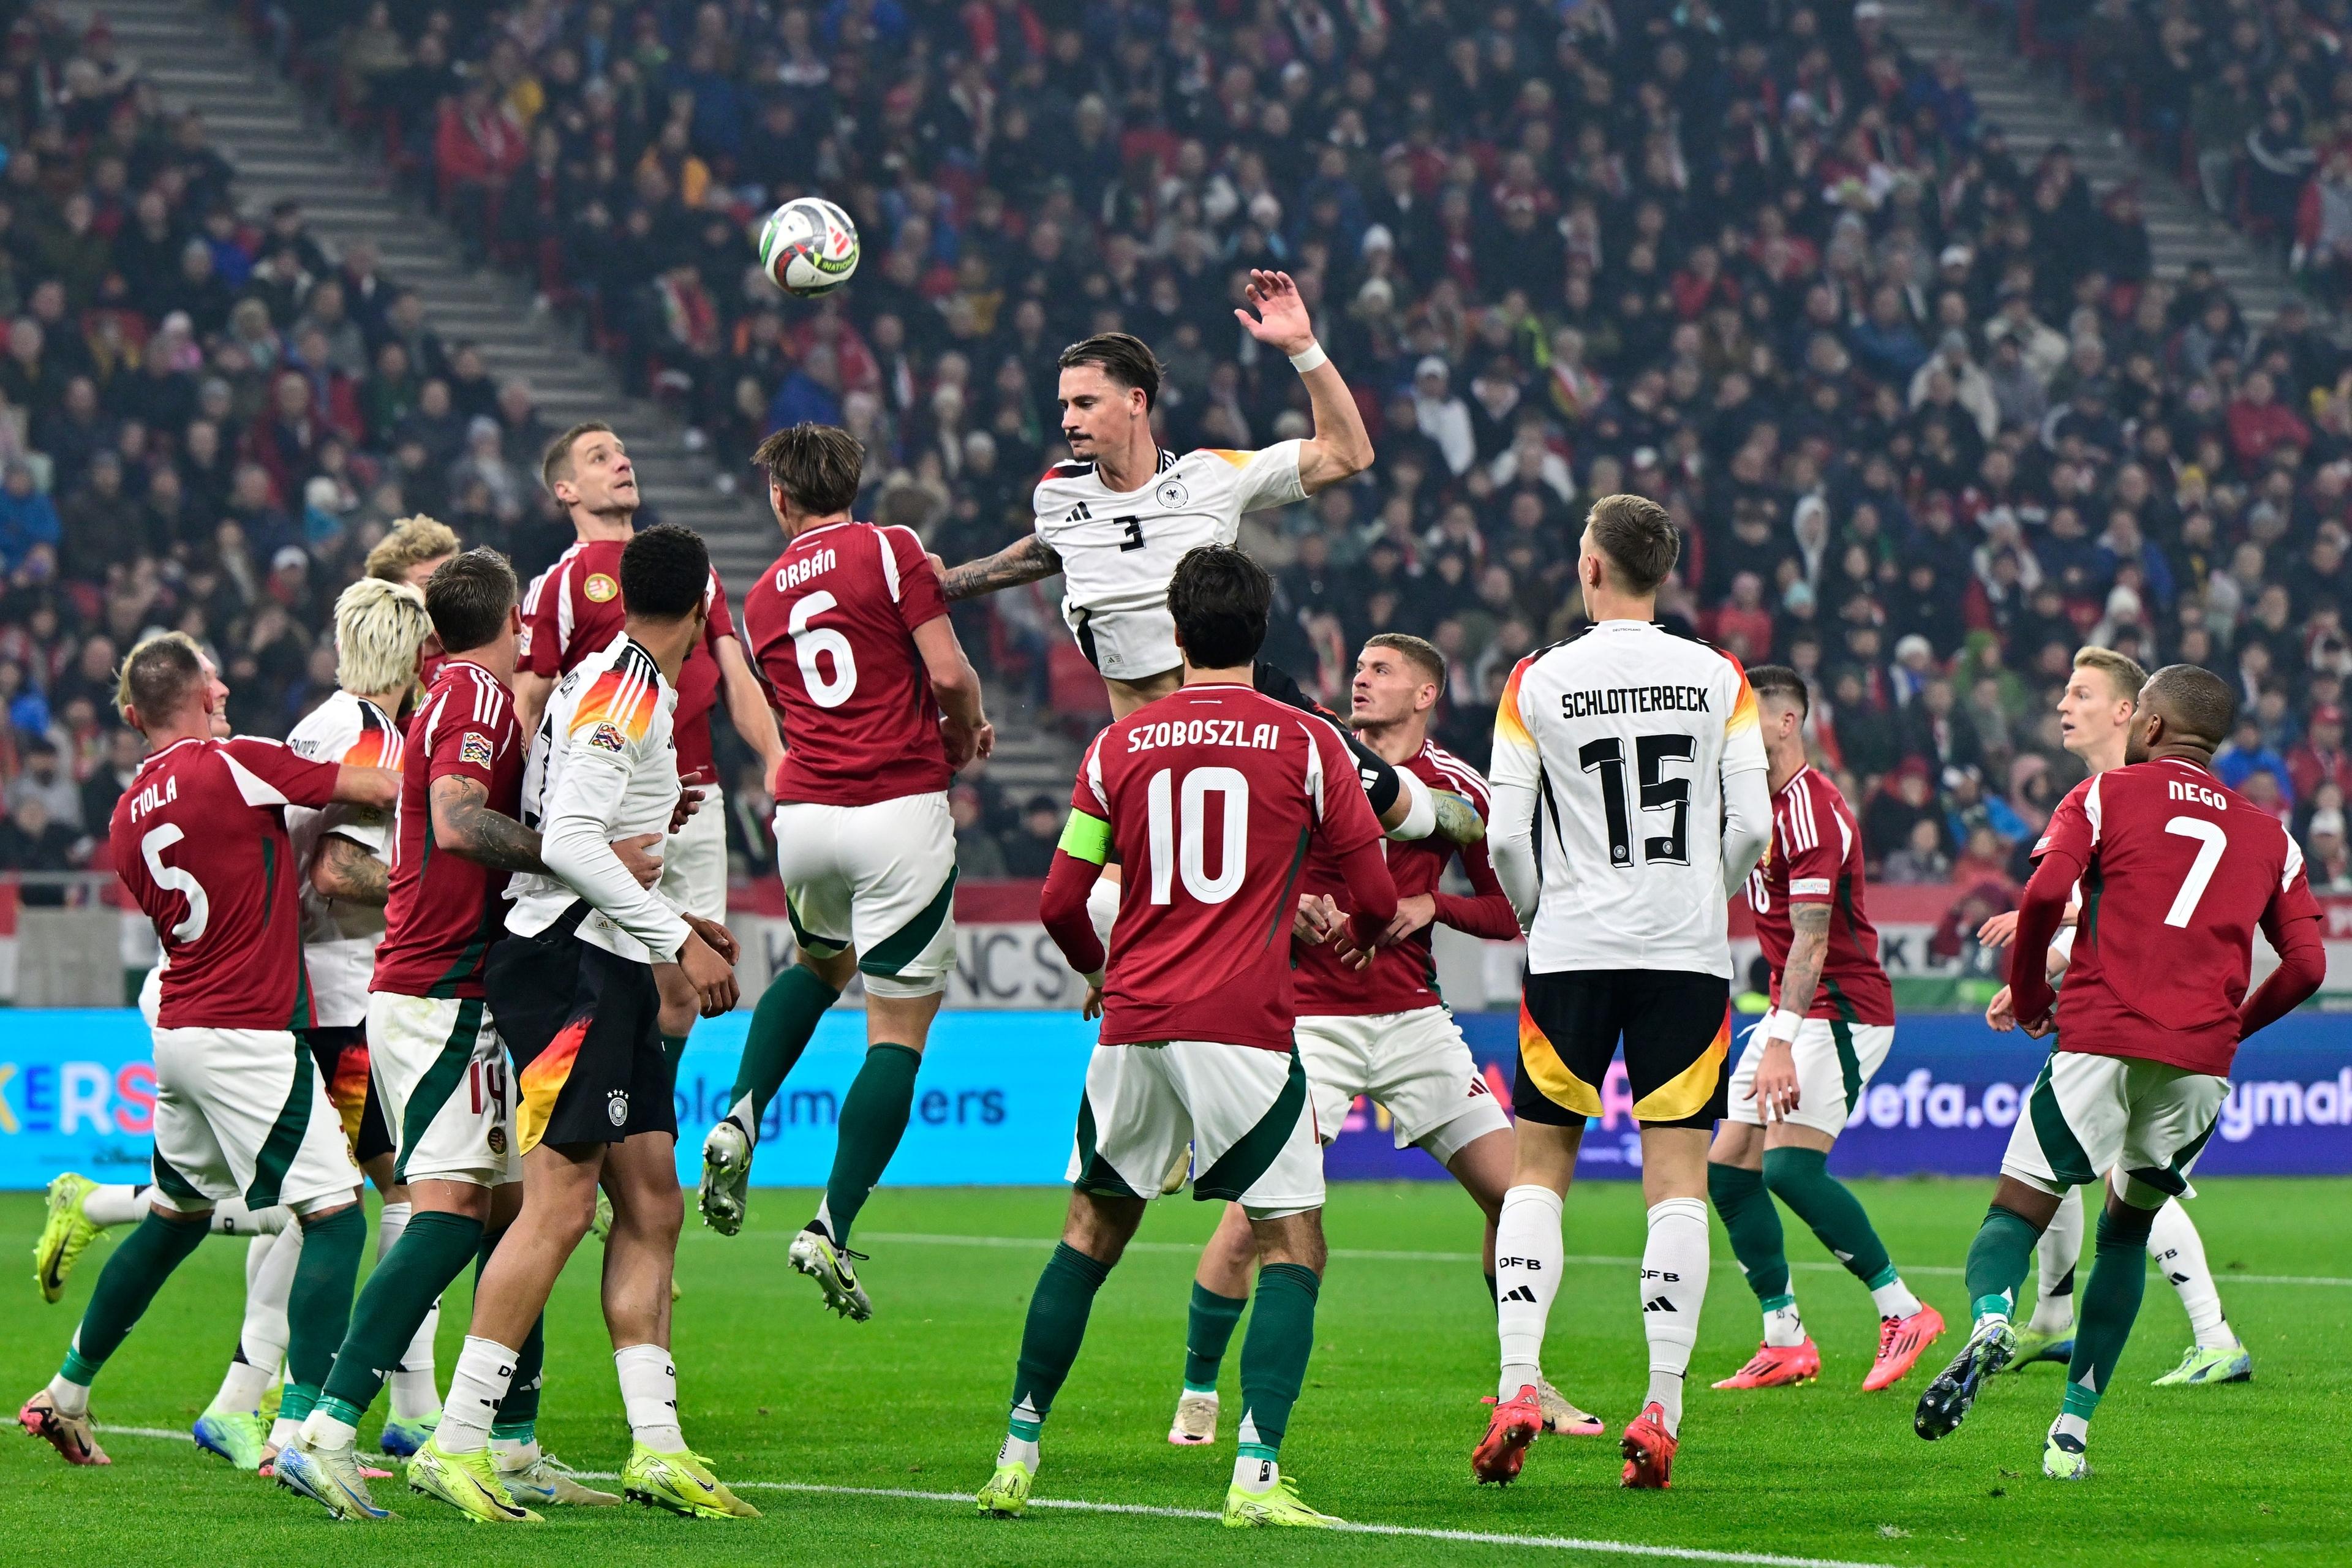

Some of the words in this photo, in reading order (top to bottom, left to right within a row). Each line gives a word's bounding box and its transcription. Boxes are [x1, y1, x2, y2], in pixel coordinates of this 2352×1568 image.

[1113, 514, 1146, 554] 3
[775, 549, 836, 593] ORBÁN
[788, 590, 857, 708] 6
[1562, 685, 1709, 719] SCHLOTTERBECK
[1127, 718, 1280, 753] SZOBOSZLAI
[130, 775, 177, 823] FIOLA
[1578, 733, 1697, 869] 15
[2169, 780, 2227, 811] NEGO
[1148, 766, 1250, 906] 10
[141, 823, 209, 943] 5
[2164, 816, 2228, 929] 7
[1499, 1257, 1542, 1270] DFB
[1641, 1268, 1680, 1282] DFB
